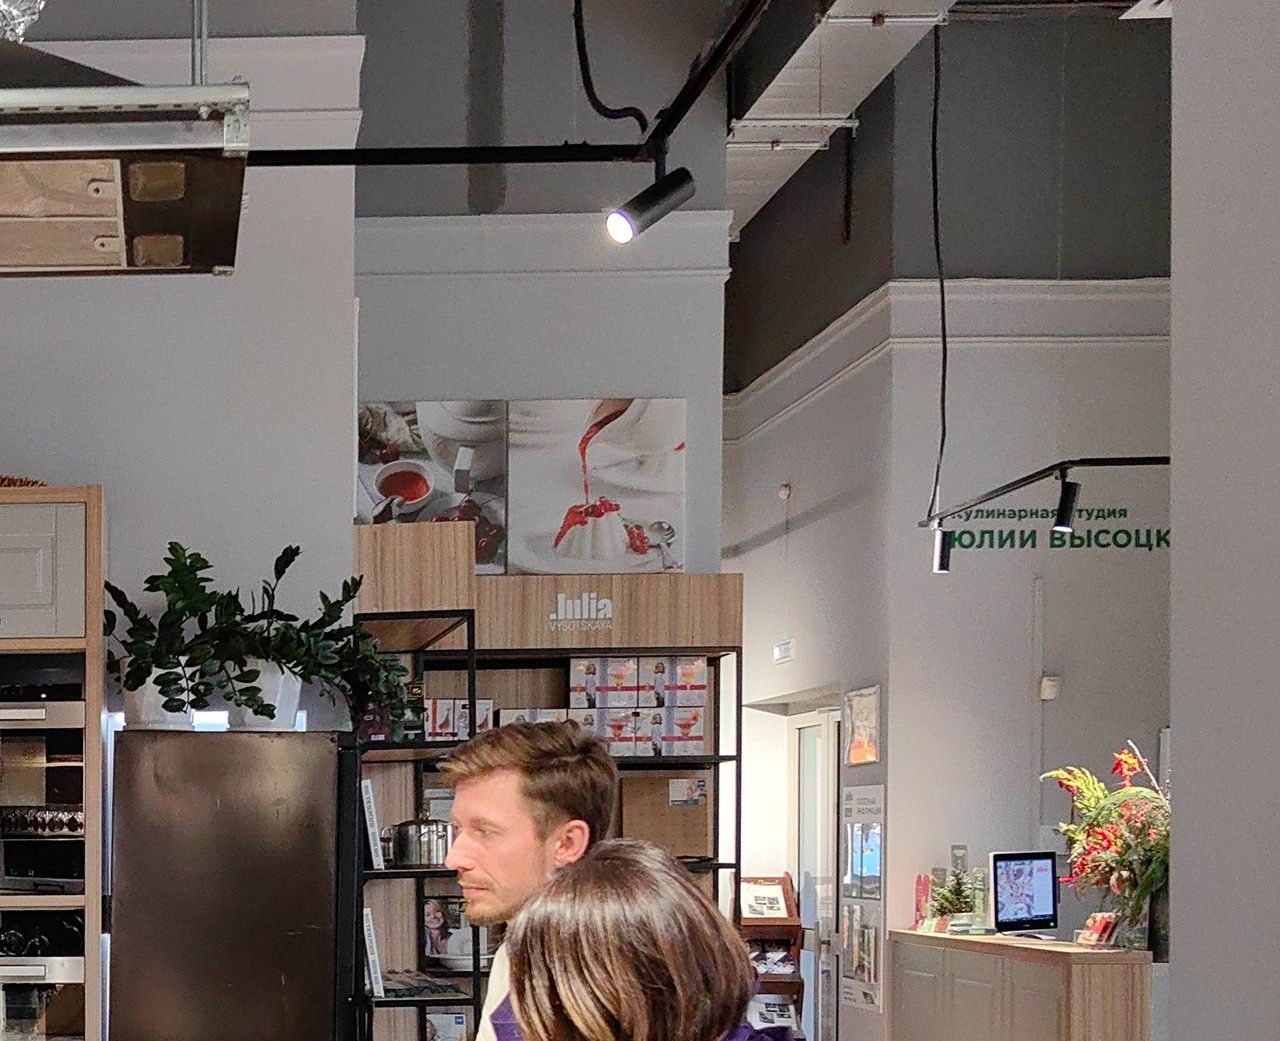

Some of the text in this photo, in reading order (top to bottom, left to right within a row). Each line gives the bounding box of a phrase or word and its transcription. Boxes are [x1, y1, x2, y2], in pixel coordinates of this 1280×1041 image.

[1077, 507, 1128, 521] тудия
[951, 529, 1038, 549] ЮЛИИ
[549, 592, 613, 620] Julia
[549, 620, 613, 632] VYSOTSKAYA
